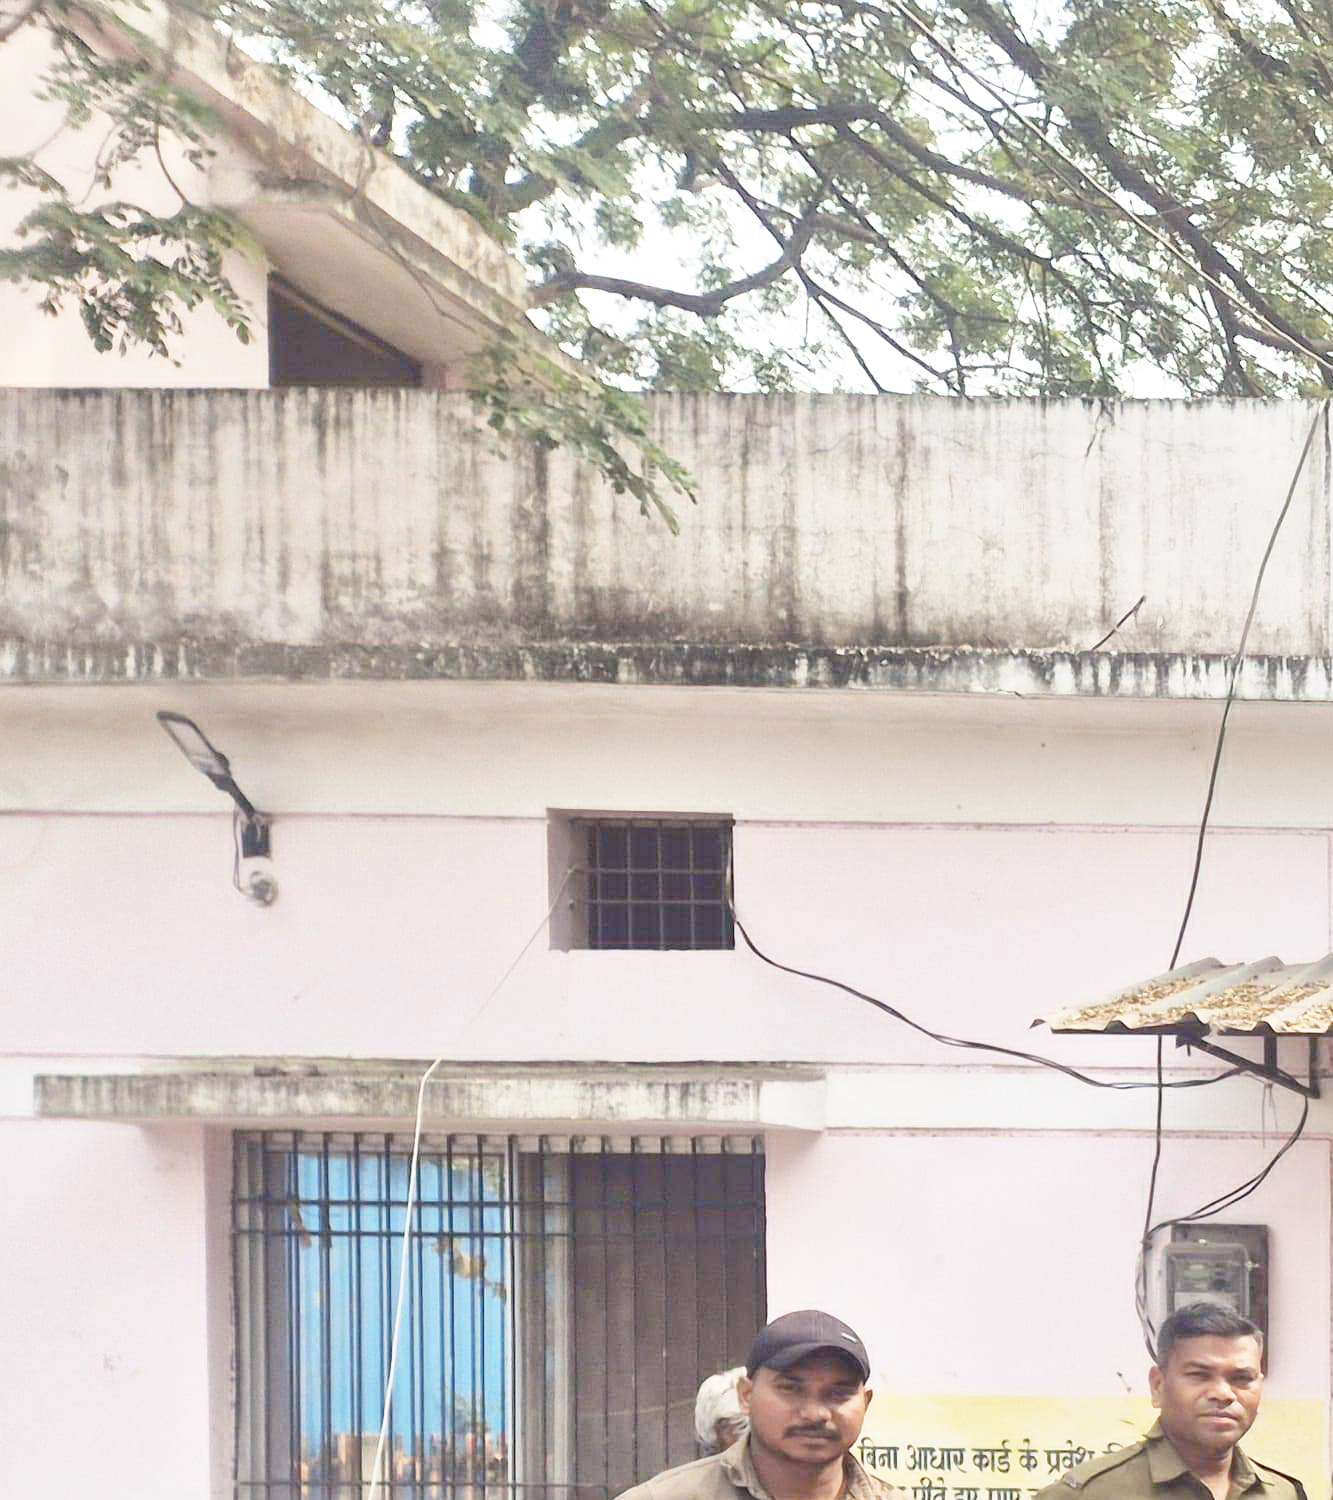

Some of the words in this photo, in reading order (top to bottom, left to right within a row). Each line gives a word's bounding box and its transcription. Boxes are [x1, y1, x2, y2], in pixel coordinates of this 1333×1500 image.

[857, 1437, 899, 1470] बिना
[906, 1444, 967, 1473] आधार
[971, 1439, 1012, 1473] कार्ड
[1018, 1438, 1039, 1472] के
